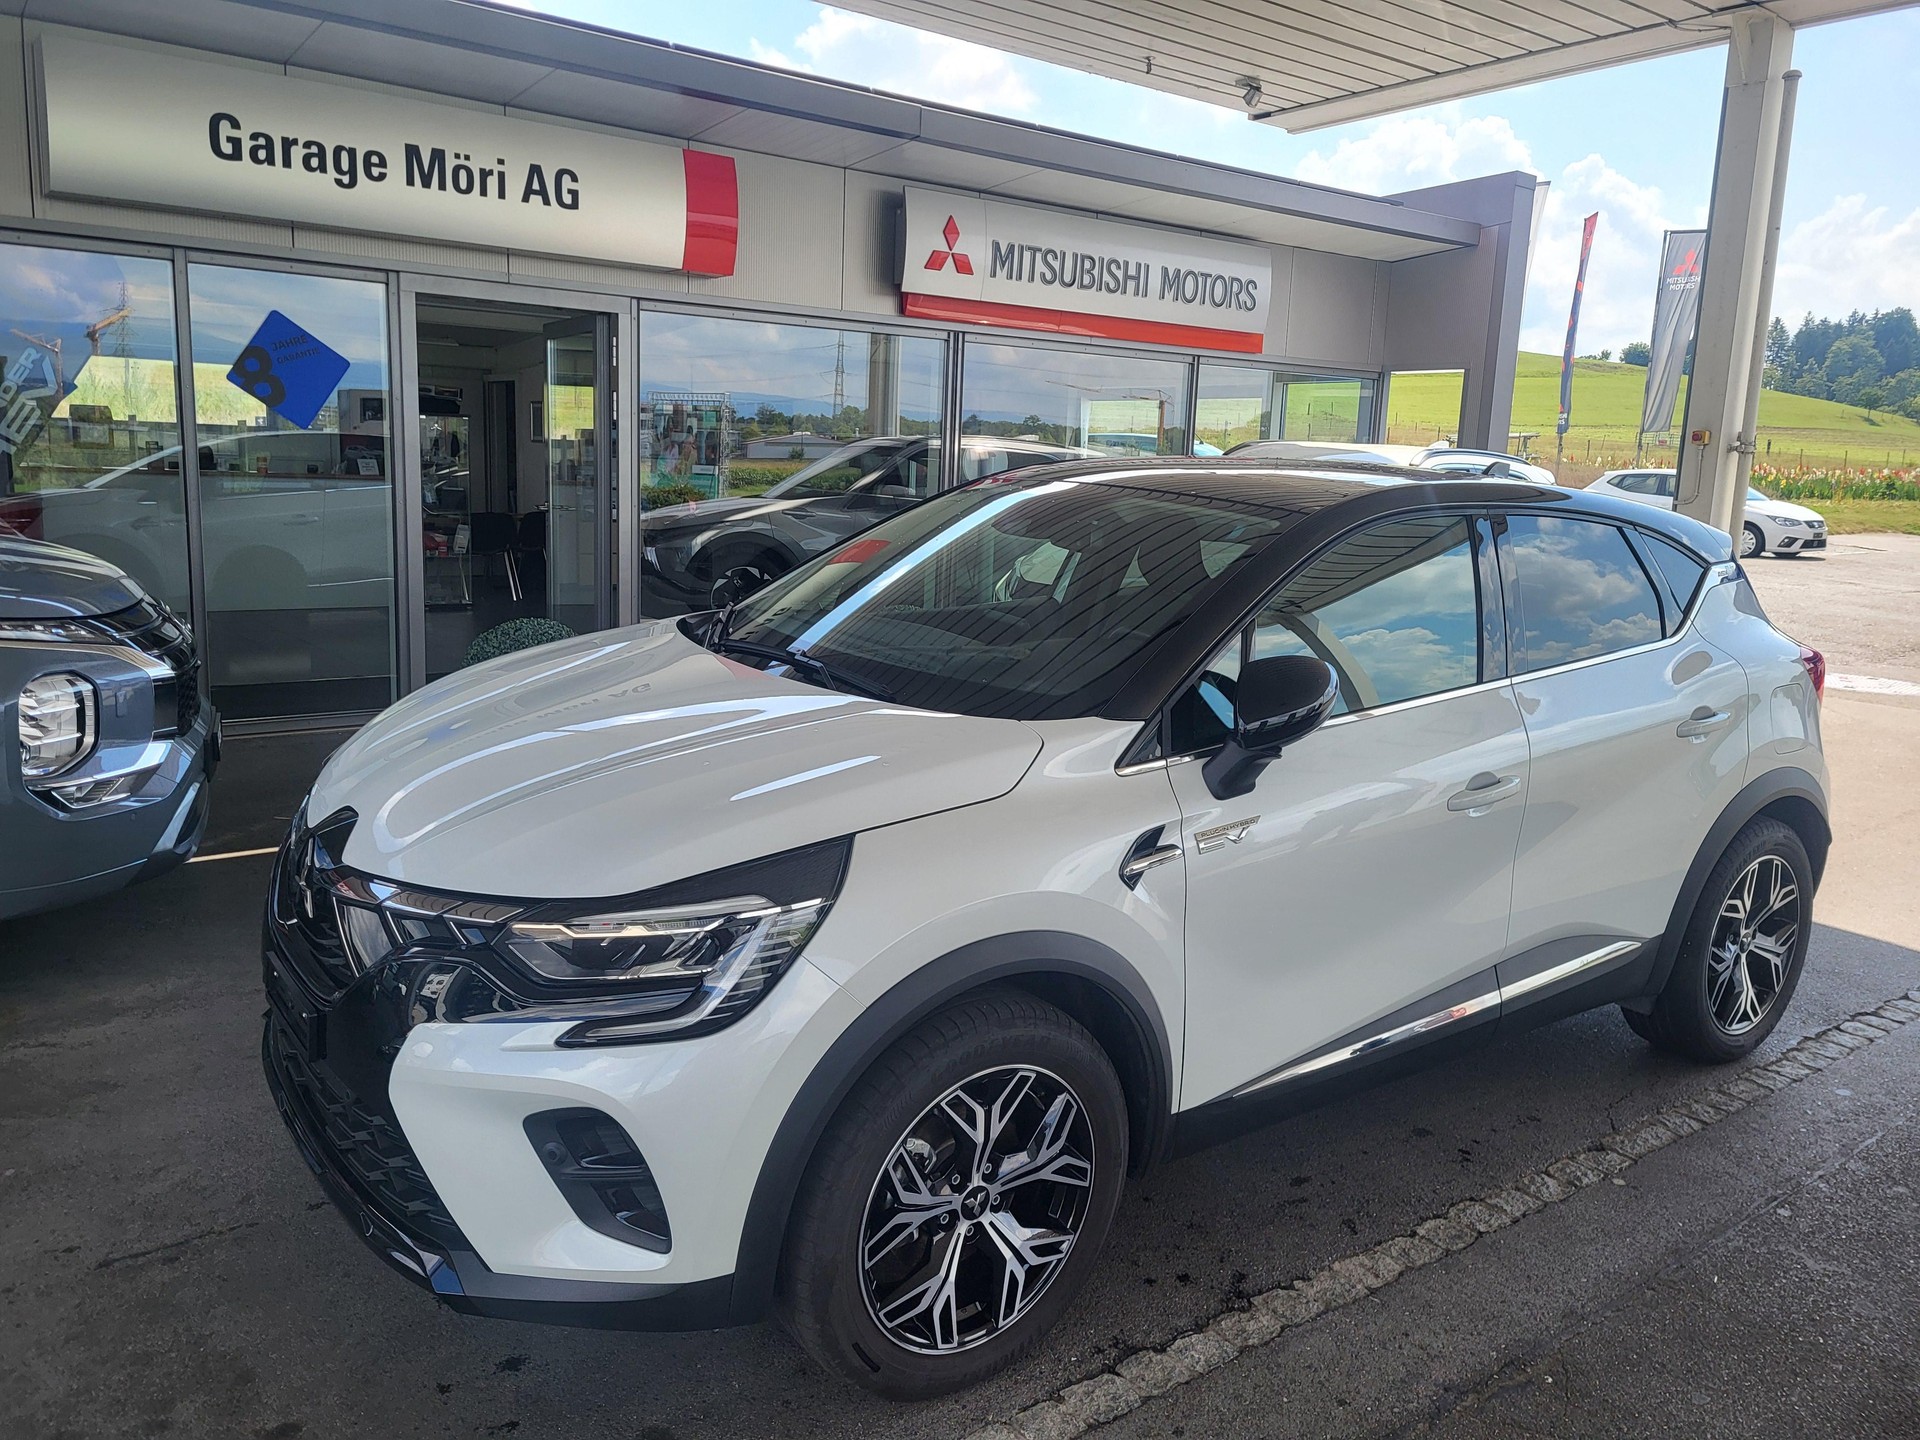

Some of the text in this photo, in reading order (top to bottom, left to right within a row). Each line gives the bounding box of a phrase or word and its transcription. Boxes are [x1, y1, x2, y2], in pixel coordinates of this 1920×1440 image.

[208, 112, 580, 211] Garage Möri AG
[989, 239, 1258, 312] MITSUBISHI MOTORS
[1666, 275, 1701, 284] MITSUSH
[1669, 282, 1695, 291] MOTRS
[233, 345, 287, 408] 8
